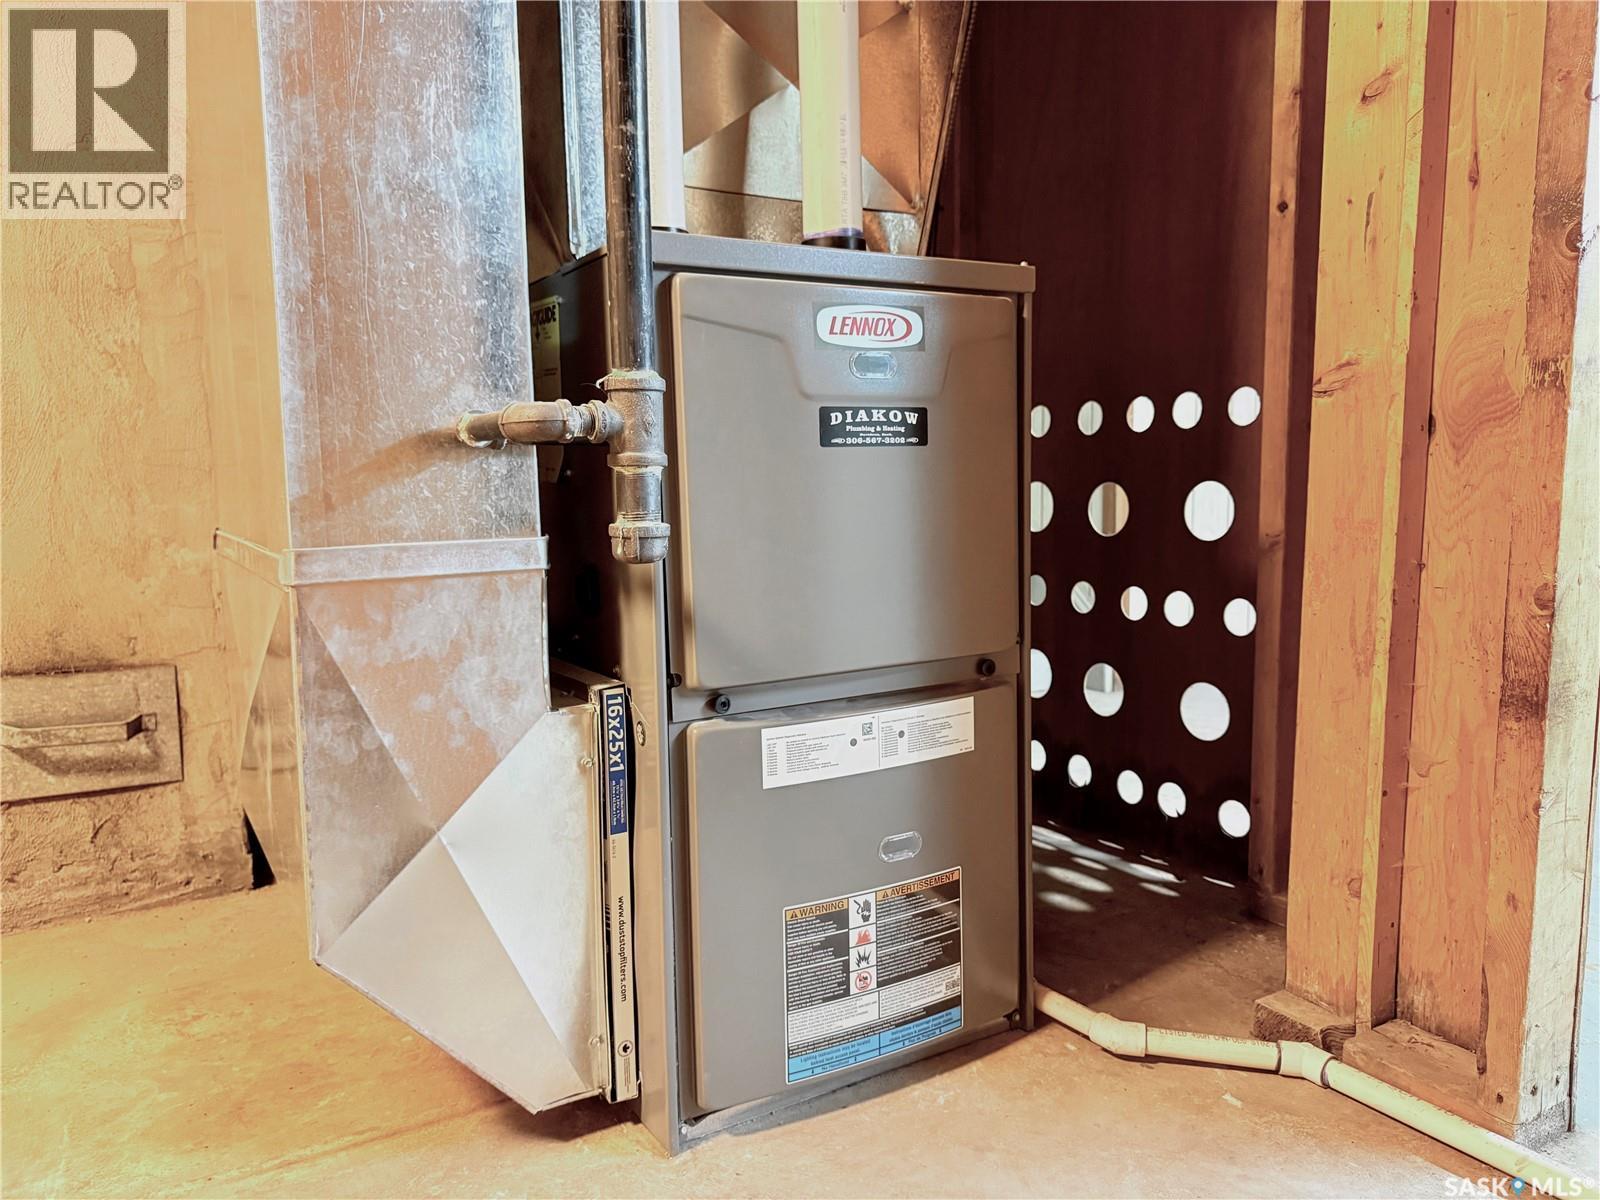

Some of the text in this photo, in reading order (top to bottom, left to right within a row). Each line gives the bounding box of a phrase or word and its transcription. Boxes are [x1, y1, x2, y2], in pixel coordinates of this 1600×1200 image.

[828, 316, 897, 337] LENNOX
[830, 409, 919, 426] DIAKOW
[607, 696, 625, 772] 16x25x1
[890, 872, 955, 897] AVERTISSEMENT
[799, 901, 844, 917] WARNING
[618, 896, 628, 1002] www.duststopfilters.com
